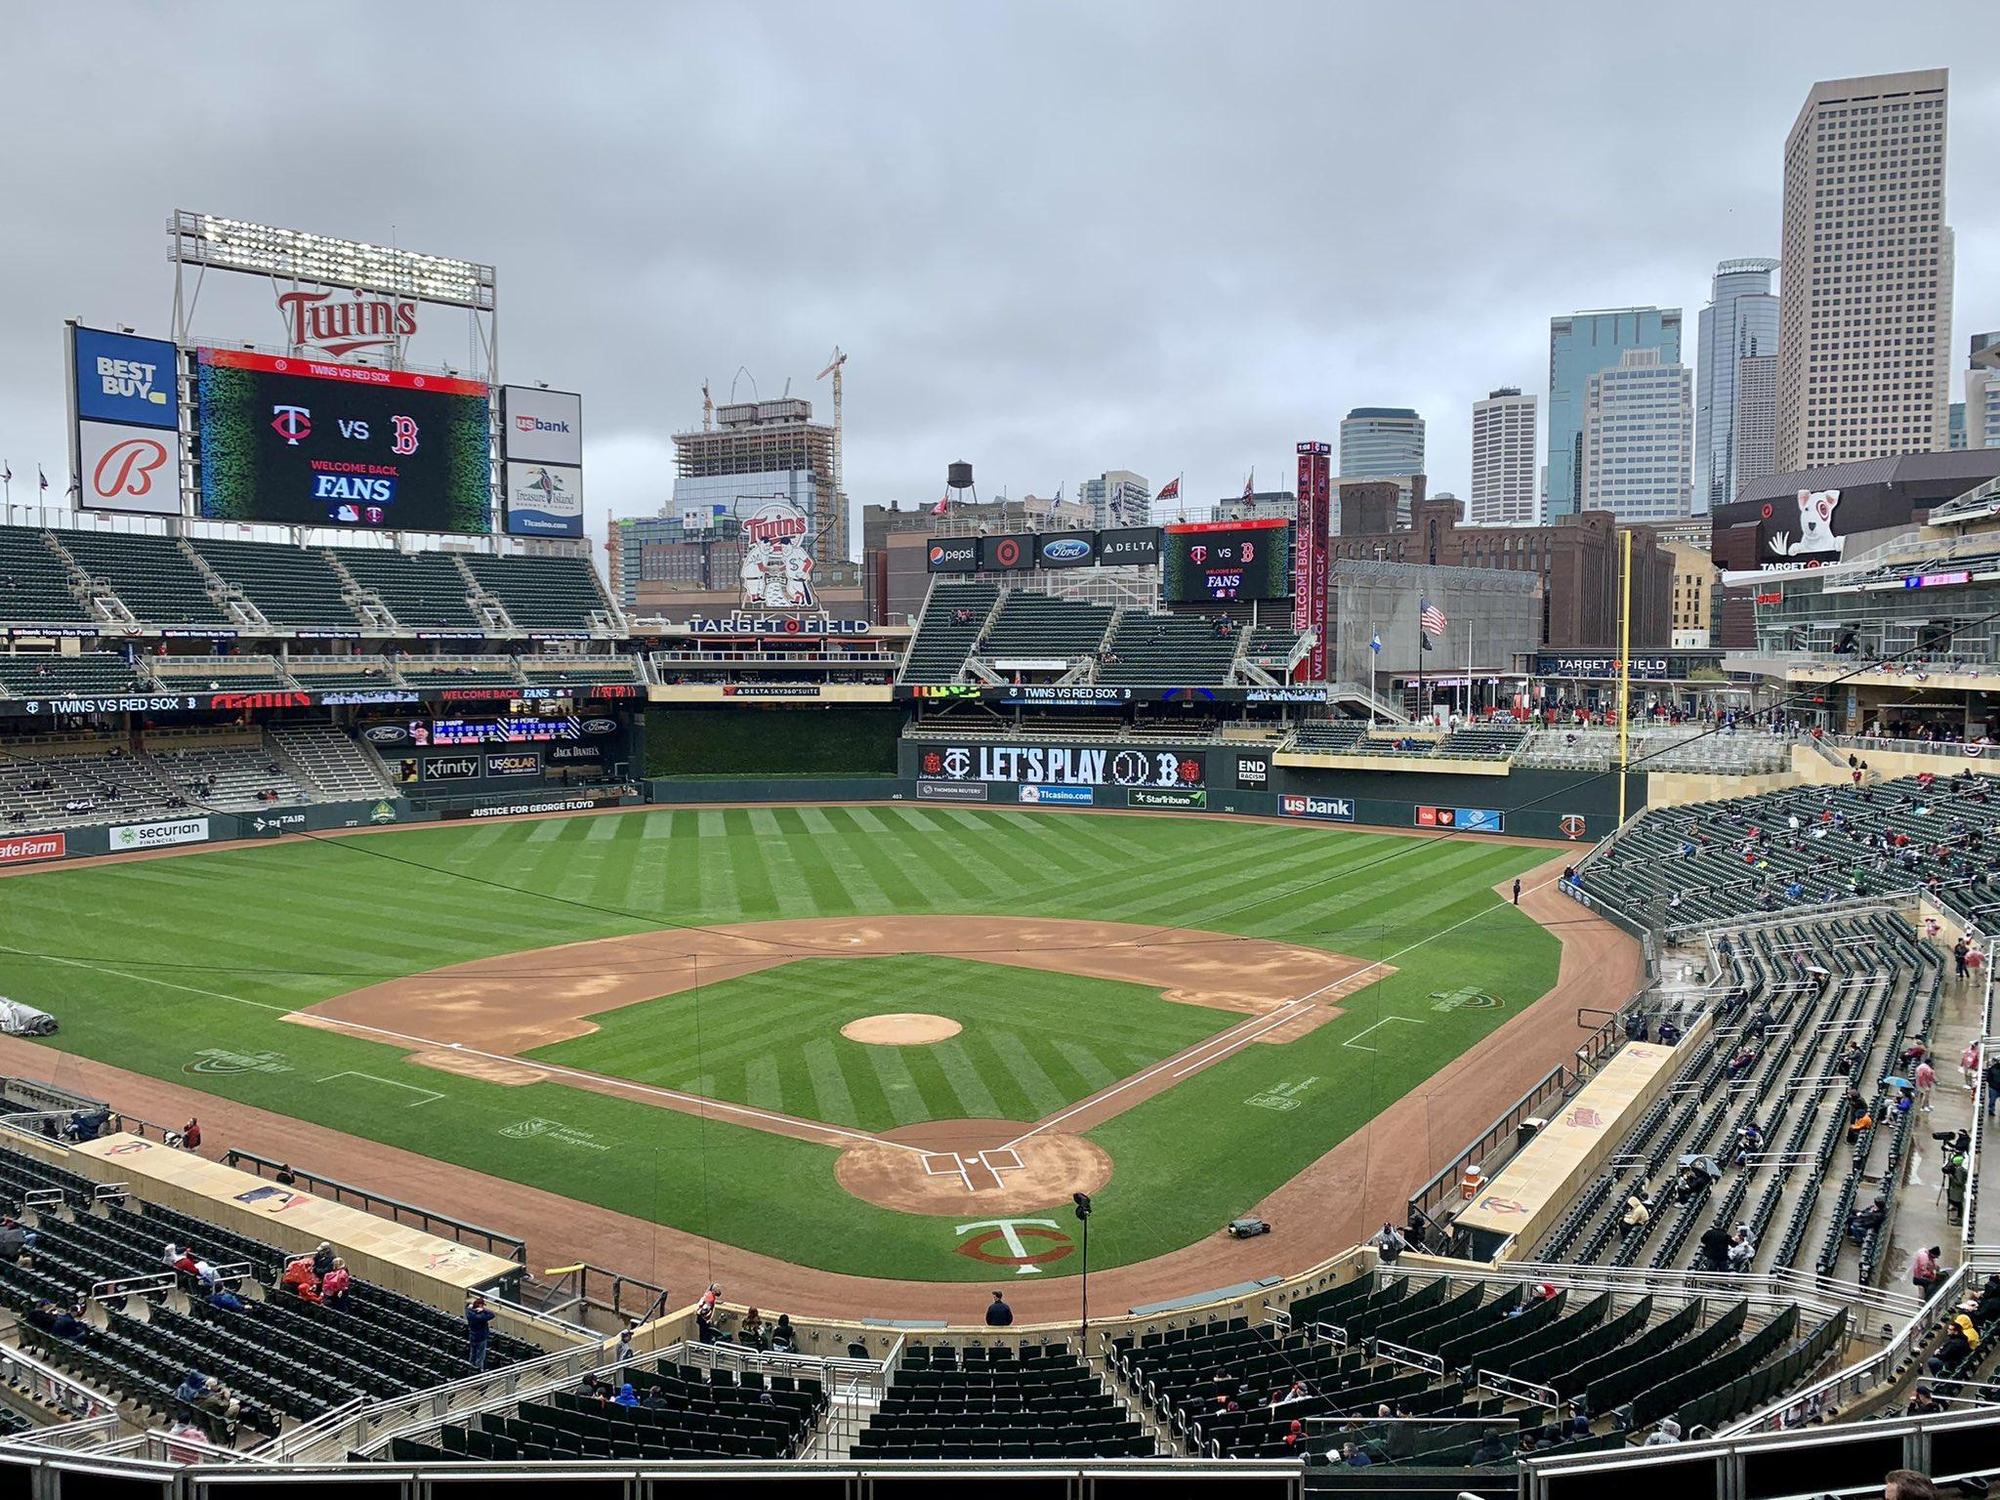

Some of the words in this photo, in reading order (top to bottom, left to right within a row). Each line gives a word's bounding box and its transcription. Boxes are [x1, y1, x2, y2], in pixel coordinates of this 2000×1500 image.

[276, 287, 417, 350] Twins
[97, 357, 156, 382] BEST
[309, 364, 338, 376] TWINS
[339, 367, 350, 379] VS
[350, 370, 370, 380] RED
[371, 372, 390, 383] SOX
[103, 376, 151, 400] BUY
[338, 419, 369, 440] VS
[391, 415, 419, 455] B
[311, 460, 366, 474] WELCOME
[315, 475, 390, 501] FANS
[515, 489, 546, 502] Treasure
[552, 493, 574, 504] Island
[742, 514, 807, 545] Twins
[1052, 543, 1081, 559] Ford
[1116, 541, 1154, 552] DELTA
[1218, 548, 1231, 558] VS
[945, 548, 975, 560] pepsi
[1760, 562, 1807, 571] TARGET
[1207, 576, 1240, 587] FANS
[1297, 567, 1307, 630] WELCOME
[690, 620, 780, 633] TARGET
[804, 620, 870, 633] FIELD
[1315, 599, 1324, 678] WELCOME
[1558, 660, 1609, 669] TARGET
[441, 690, 488, 700] WELCOME
[494, 689, 519, 698] BACK
[523, 689, 549, 698] FANS
[1024, 688, 1055, 697] TWINS
[1057, 688, 1071, 697] VS
[1073, 689, 1093, 698] RED
[1095, 689, 1117, 698] SOX
[49, 701, 95, 713] TWINS
[98, 700, 117, 712] VS
[119, 699, 148, 711] RED
[150, 698, 179, 710] SOX
[588, 722, 609, 732] Ford
[373, 730, 398, 740] Ford
[553, 747, 571, 757] JACK
[573, 746, 600, 757] DANIEL'S
[427, 759, 477, 778] xfinity
[502, 757, 536, 769] SOLAR
[980, 747, 1044, 782] LET'S
[1048, 748, 1107, 784] PLAY
[1238, 761, 1266, 772] END
[1146, 796, 1190, 805] StarTribune
[470, 807, 509, 817] JUSTICE
[510, 805, 528, 814] FOR
[529, 803, 565, 812] GEORGE
[566, 801, 594, 809] FLOYD
[139, 823, 200, 839] securian
